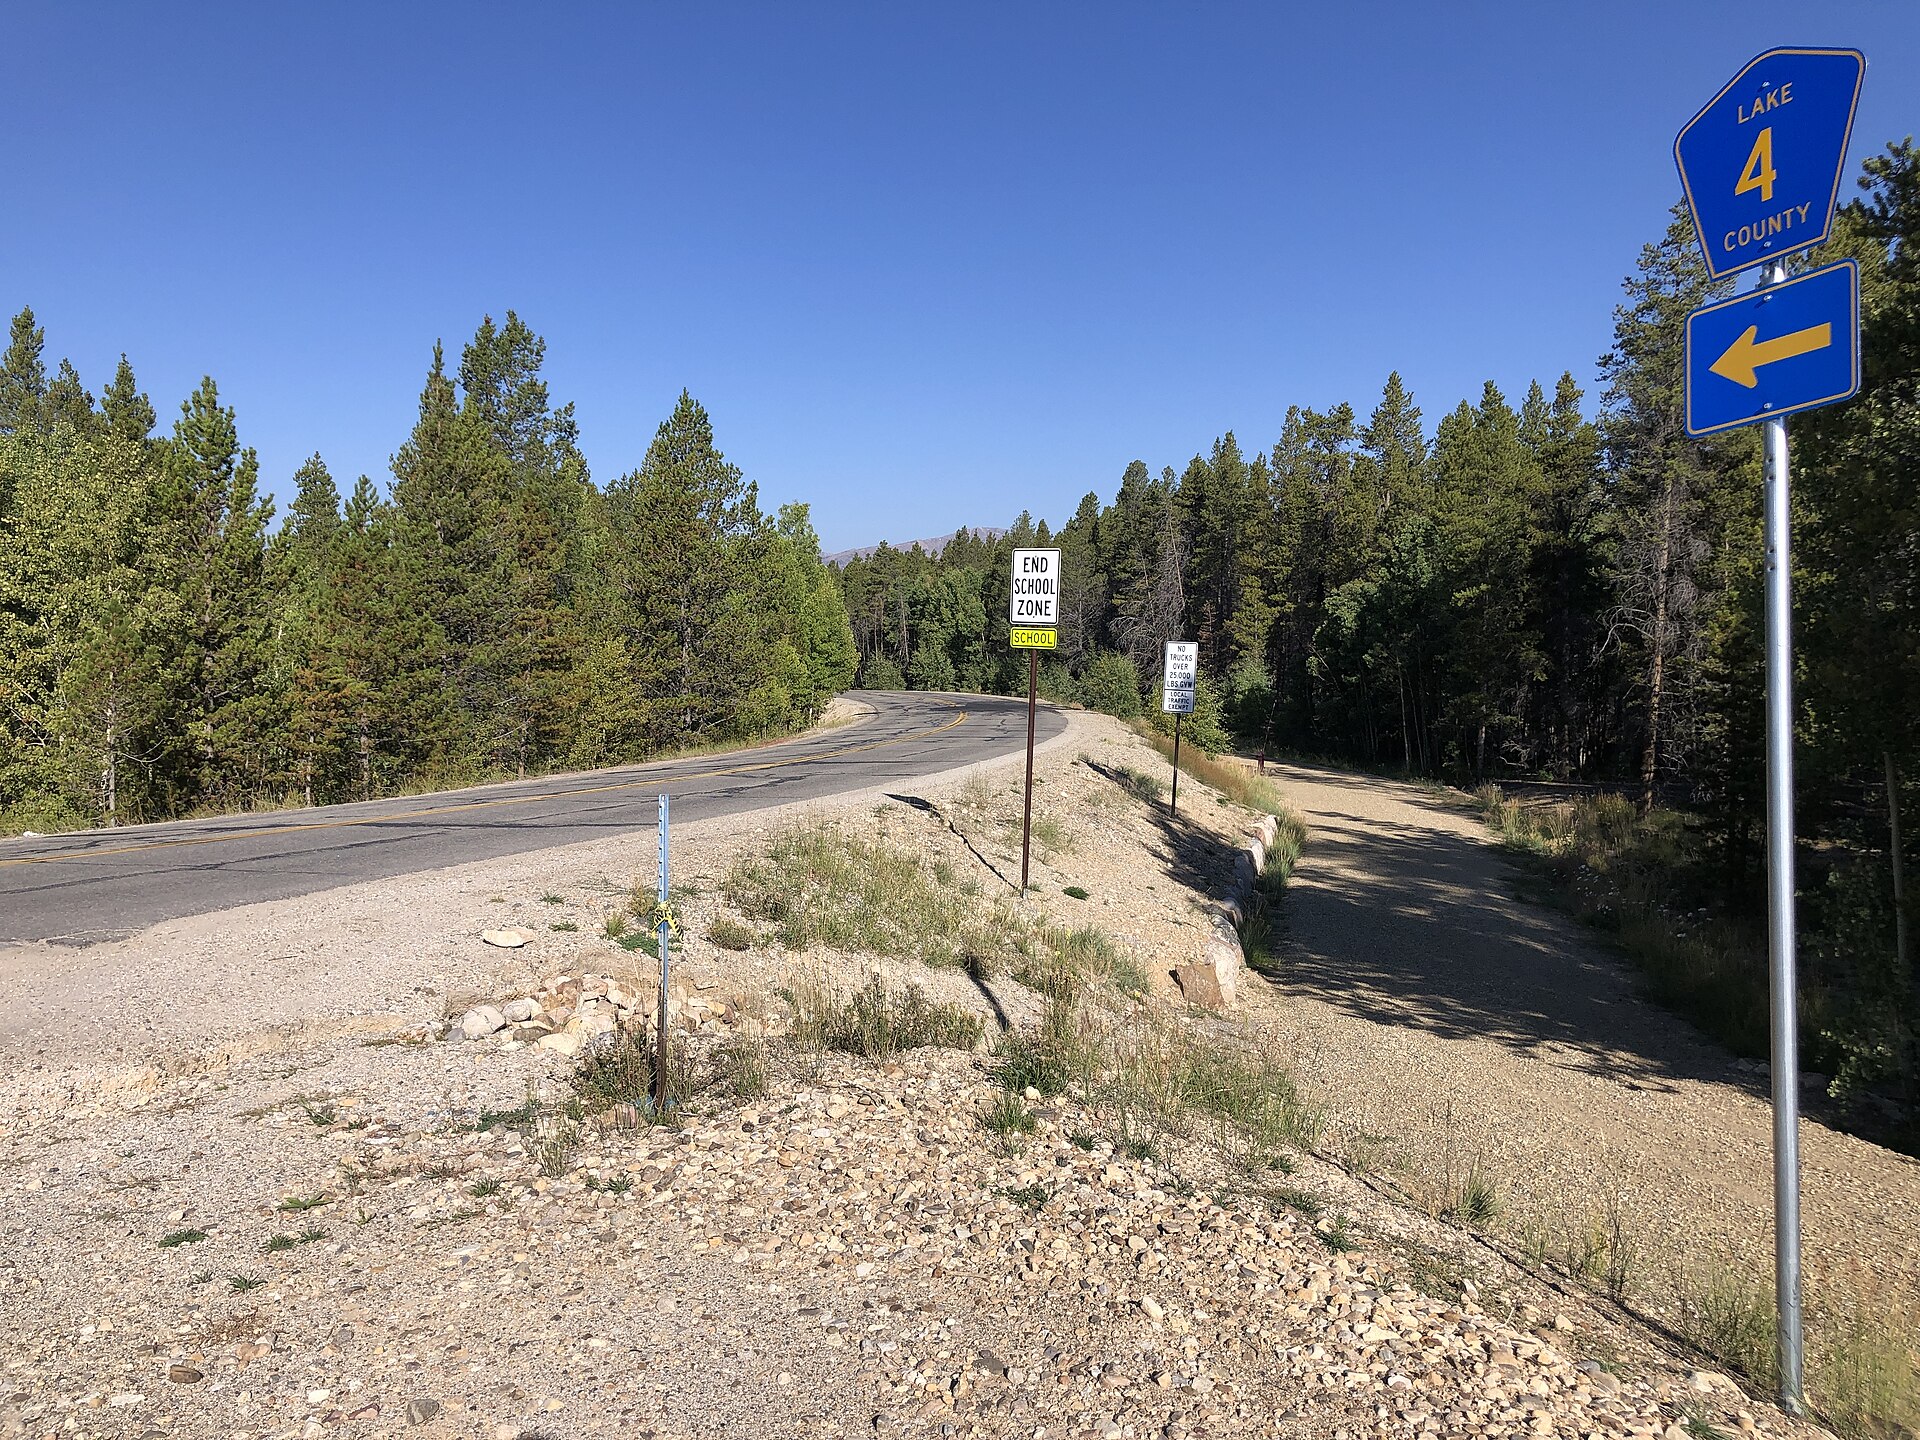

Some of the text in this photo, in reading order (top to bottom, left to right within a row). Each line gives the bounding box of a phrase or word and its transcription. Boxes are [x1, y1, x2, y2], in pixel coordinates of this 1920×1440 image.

[1737, 82, 1794, 125] LAKE
[1735, 126, 1777, 203] 4
[1723, 201, 1812, 253] COUNTY
[1023, 556, 1048, 573] END
[1014, 578, 1056, 595] SCHOOL
[1017, 599, 1052, 616] ZONE
[1014, 632, 1053, 645] SCHOOL
[1177, 645, 1186, 653] NO
[1172, 663, 1189, 671] OVER
